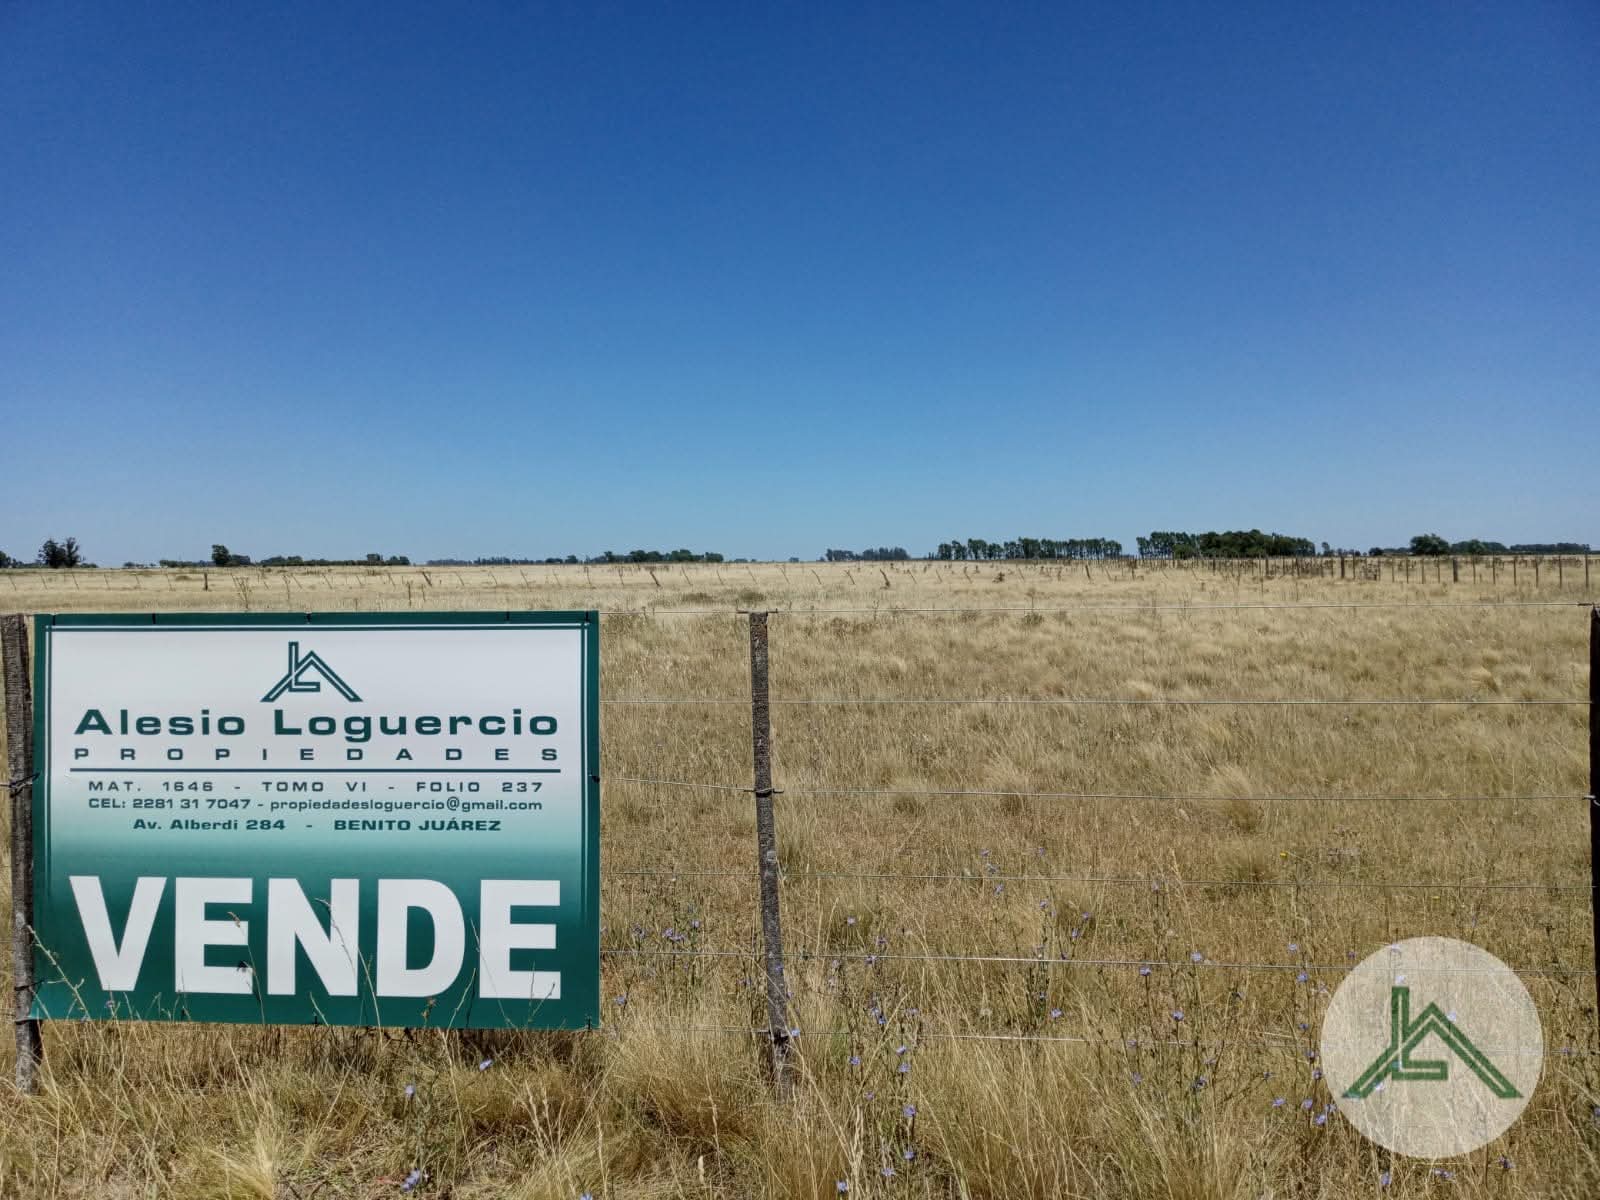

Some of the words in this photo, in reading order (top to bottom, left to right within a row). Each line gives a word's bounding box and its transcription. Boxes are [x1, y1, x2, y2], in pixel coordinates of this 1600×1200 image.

[74, 708, 246, 736] Alesio
[273, 708, 558, 743] Loguercio
[74, 747, 558, 761] PROPIEDADES
[88, 781, 142, 792] MAT.
[162, 781, 213, 792] 1646
[262, 781, 325, 793] TOMO
[345, 781, 367, 793] VI
[416, 781, 481, 793] FOLIO
[501, 781, 543, 793] 237
[88, 798, 126, 809] CEL:
[132, 798, 174, 809] 2281
[180, 798, 199, 809] 31
[206, 798, 252, 809] 7047
[270, 796, 543, 812] propiedadesloguercio@gmail.com
[133, 819, 162, 830] Av.
[169, 819, 238, 830] Alberdi
[245, 819, 286, 830] 284
[334, 819, 411, 831] BENITO
[418, 818, 502, 831] JUÁREZ
[69, 874, 562, 1000] VENDE
